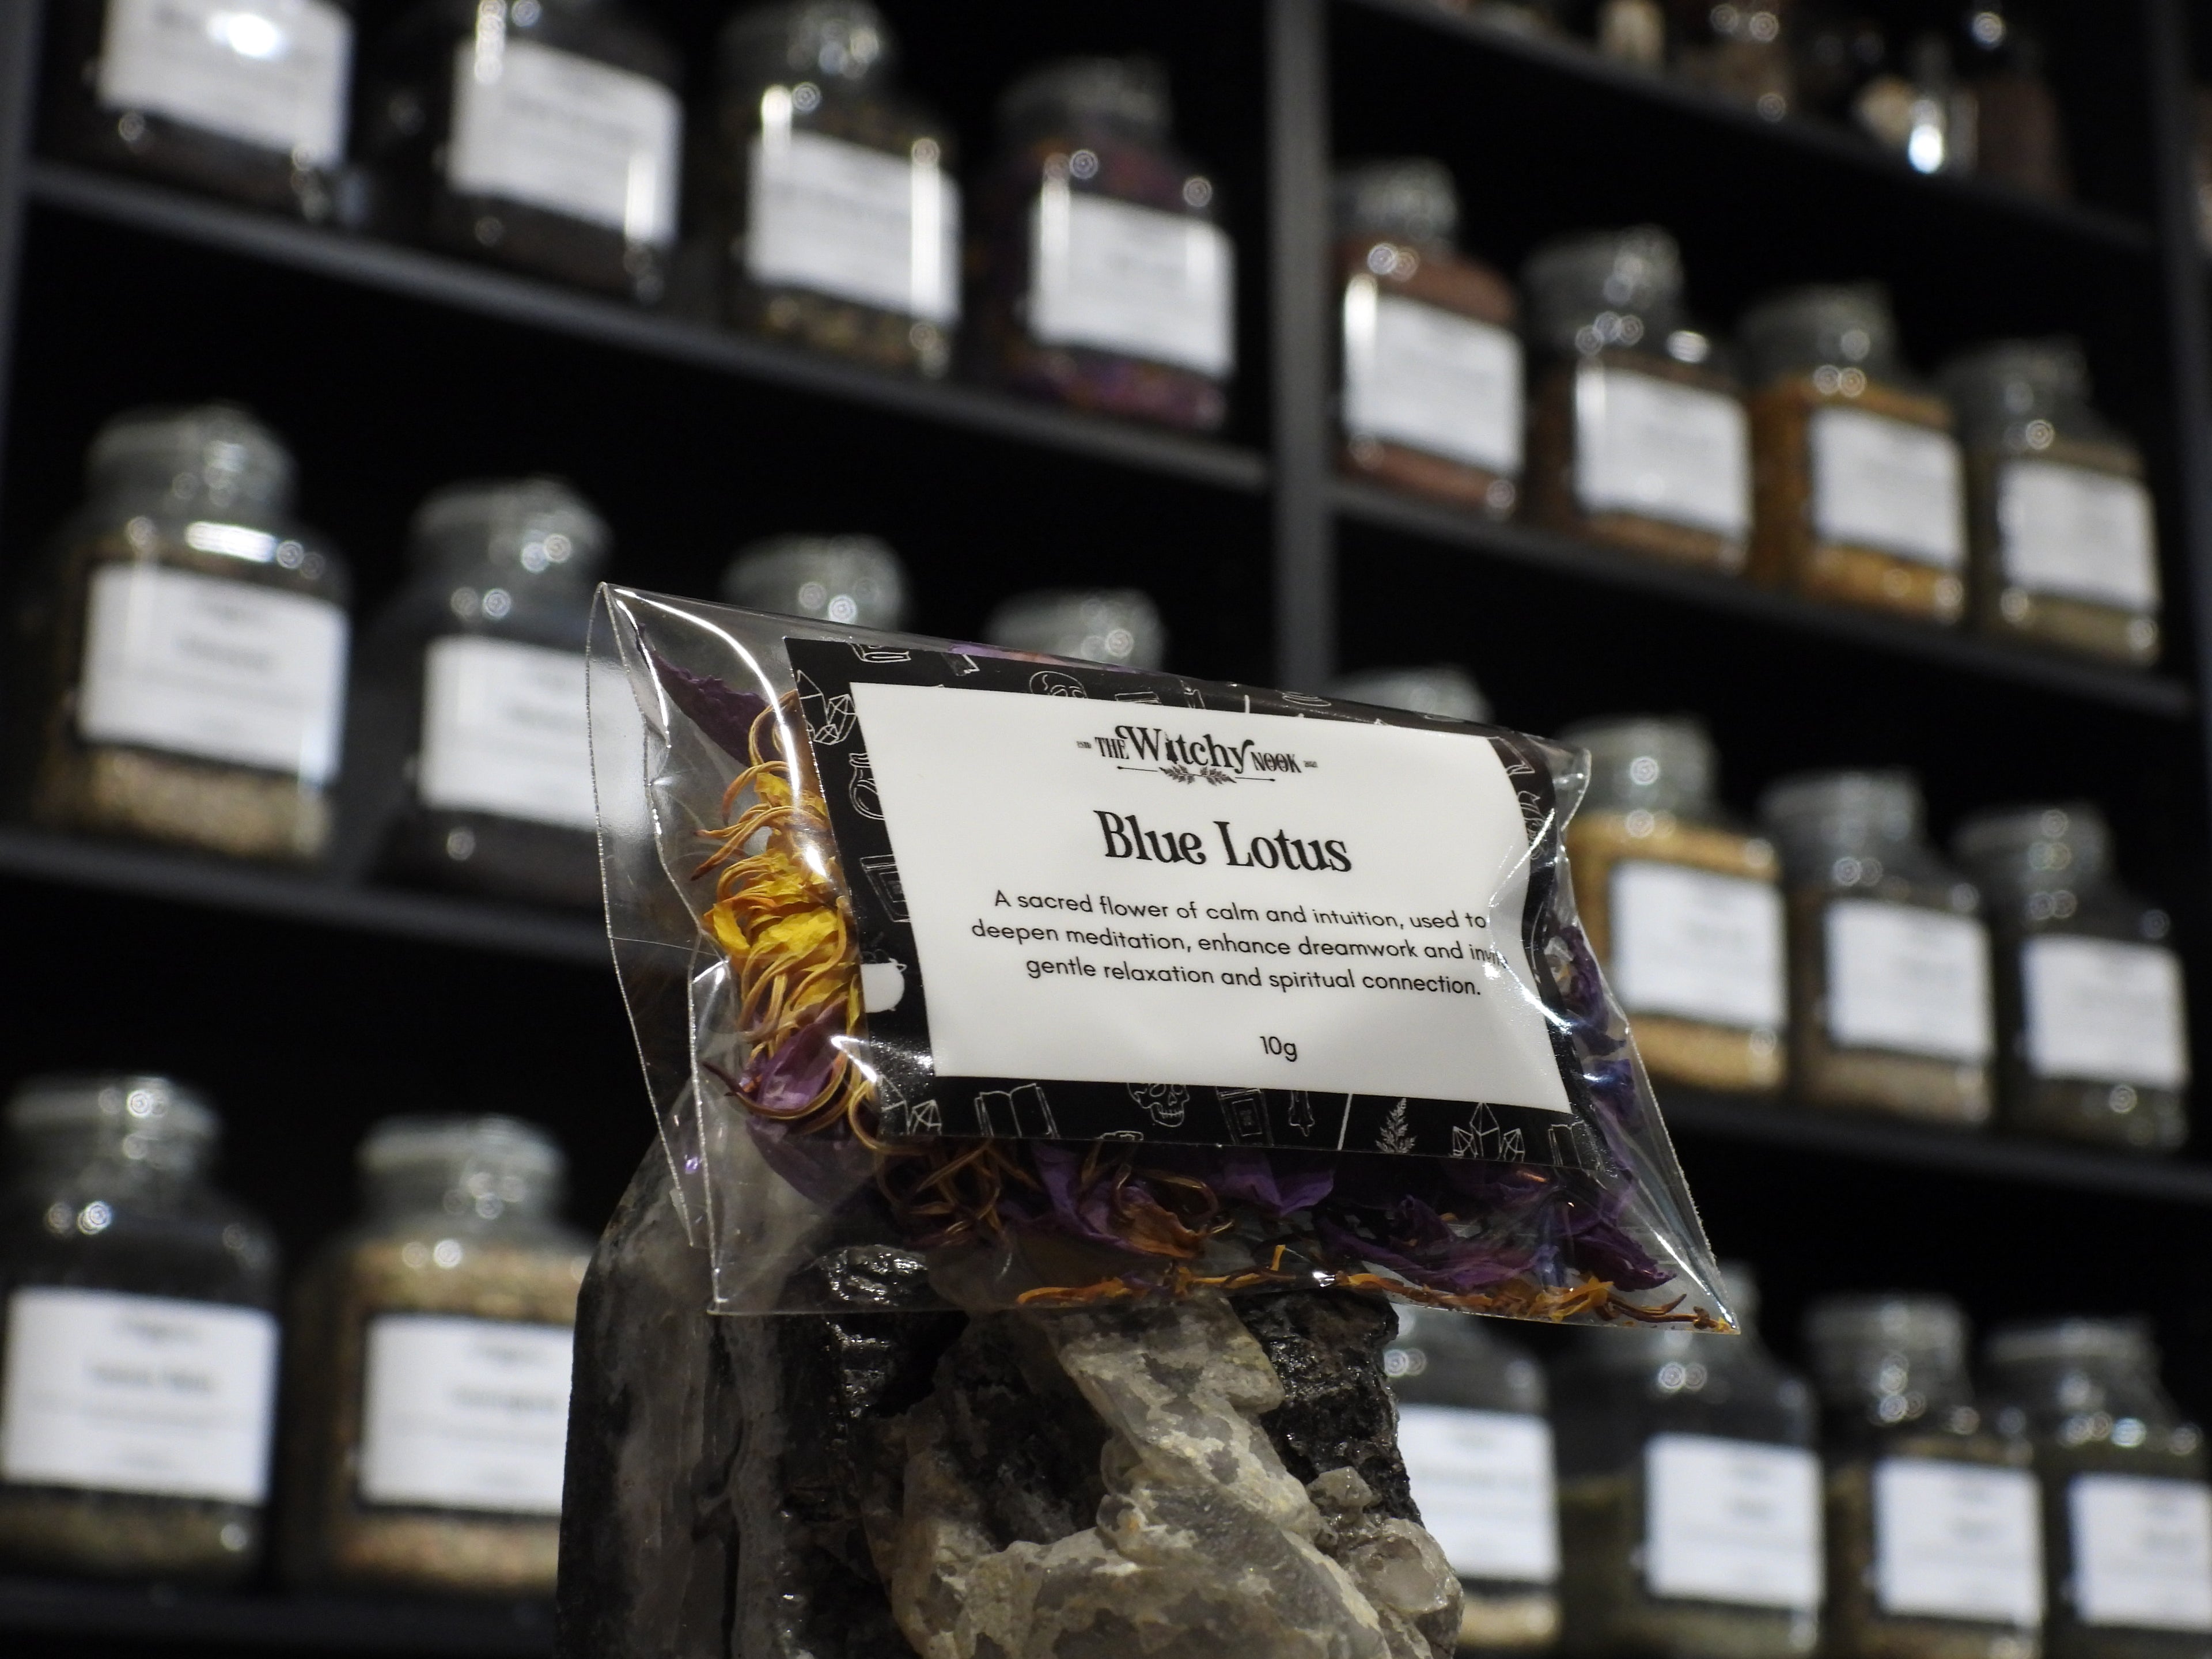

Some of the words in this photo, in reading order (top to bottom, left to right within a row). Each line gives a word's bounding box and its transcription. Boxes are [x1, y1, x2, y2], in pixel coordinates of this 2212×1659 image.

[1094, 736, 1130, 760] THE
[1114, 725, 1255, 774] Witchy
[1250, 751, 1302, 774] NOOK
[1093, 809, 1207, 865] Blue
[1212, 820, 1353, 873] Lotus
[994, 889, 1012, 907] A
[1017, 893, 1093, 913] sacred
[1099, 895, 1169, 918] flower
[1176, 900, 1199, 919] of
[1206, 902, 1260, 921] calm
[1266, 904, 1308, 923] and
[1312, 908, 1404, 930] intuition,
[1409, 910, 1460, 929] used
[1464, 912, 1487, 929] to
[971, 918, 1059, 945] deepen
[1065, 927, 1192, 953] meditation,
[1198, 932, 1291, 955] enhance
[1297, 935, 1419, 958] dreamwork
[1423, 940, 1464, 960] and
[1026, 956, 1097, 979] gentle
[1103, 960, 1215, 984] relaxation
[1220, 967, 1263, 987] and
[1268, 968, 1356, 994] spiritual
[1362, 975, 1482, 996] connection.
[1259, 1035, 1298, 1063] 10g
